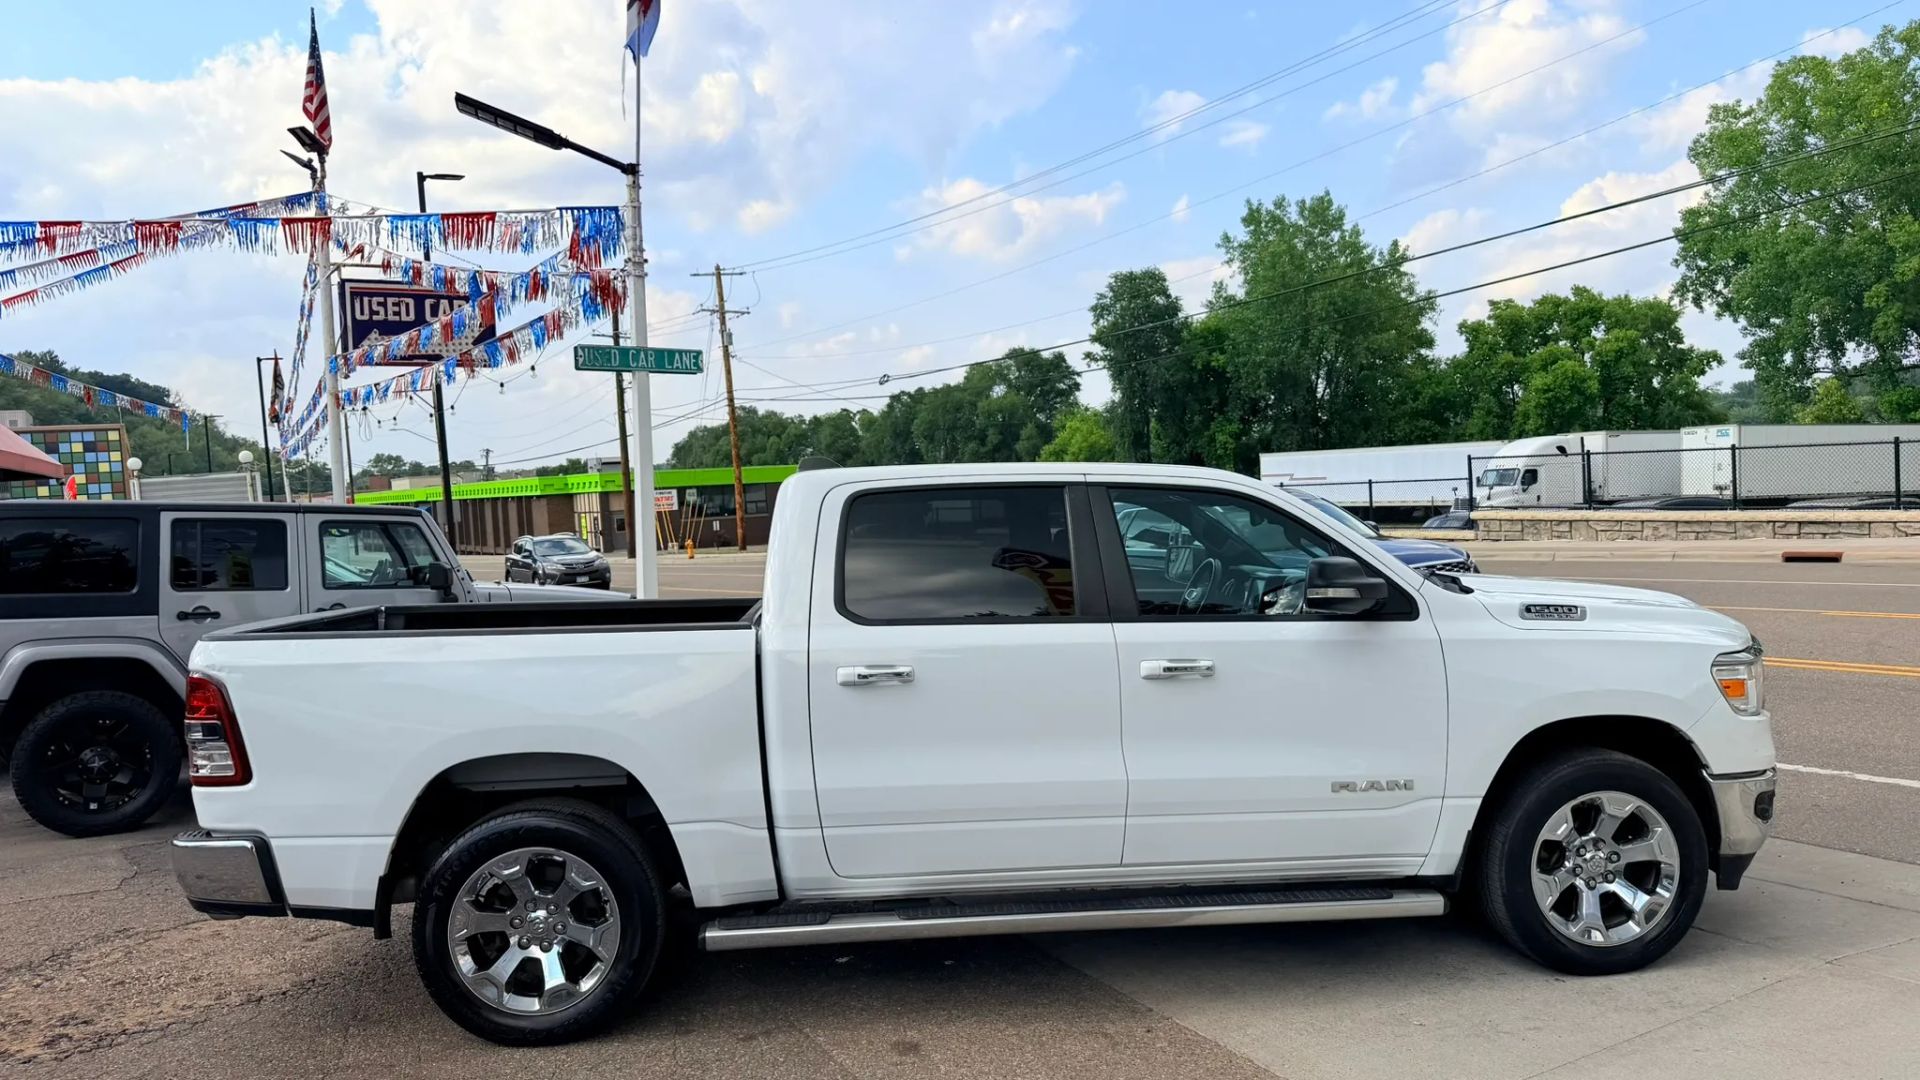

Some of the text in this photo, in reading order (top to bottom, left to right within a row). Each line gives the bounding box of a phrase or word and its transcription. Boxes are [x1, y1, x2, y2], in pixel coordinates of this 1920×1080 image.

[354, 296, 416, 322] USED
[584, 347, 698, 370] USED CAR LANE
[1527, 605, 1577, 613] 1500
[1331, 780, 1414, 793] RAM
